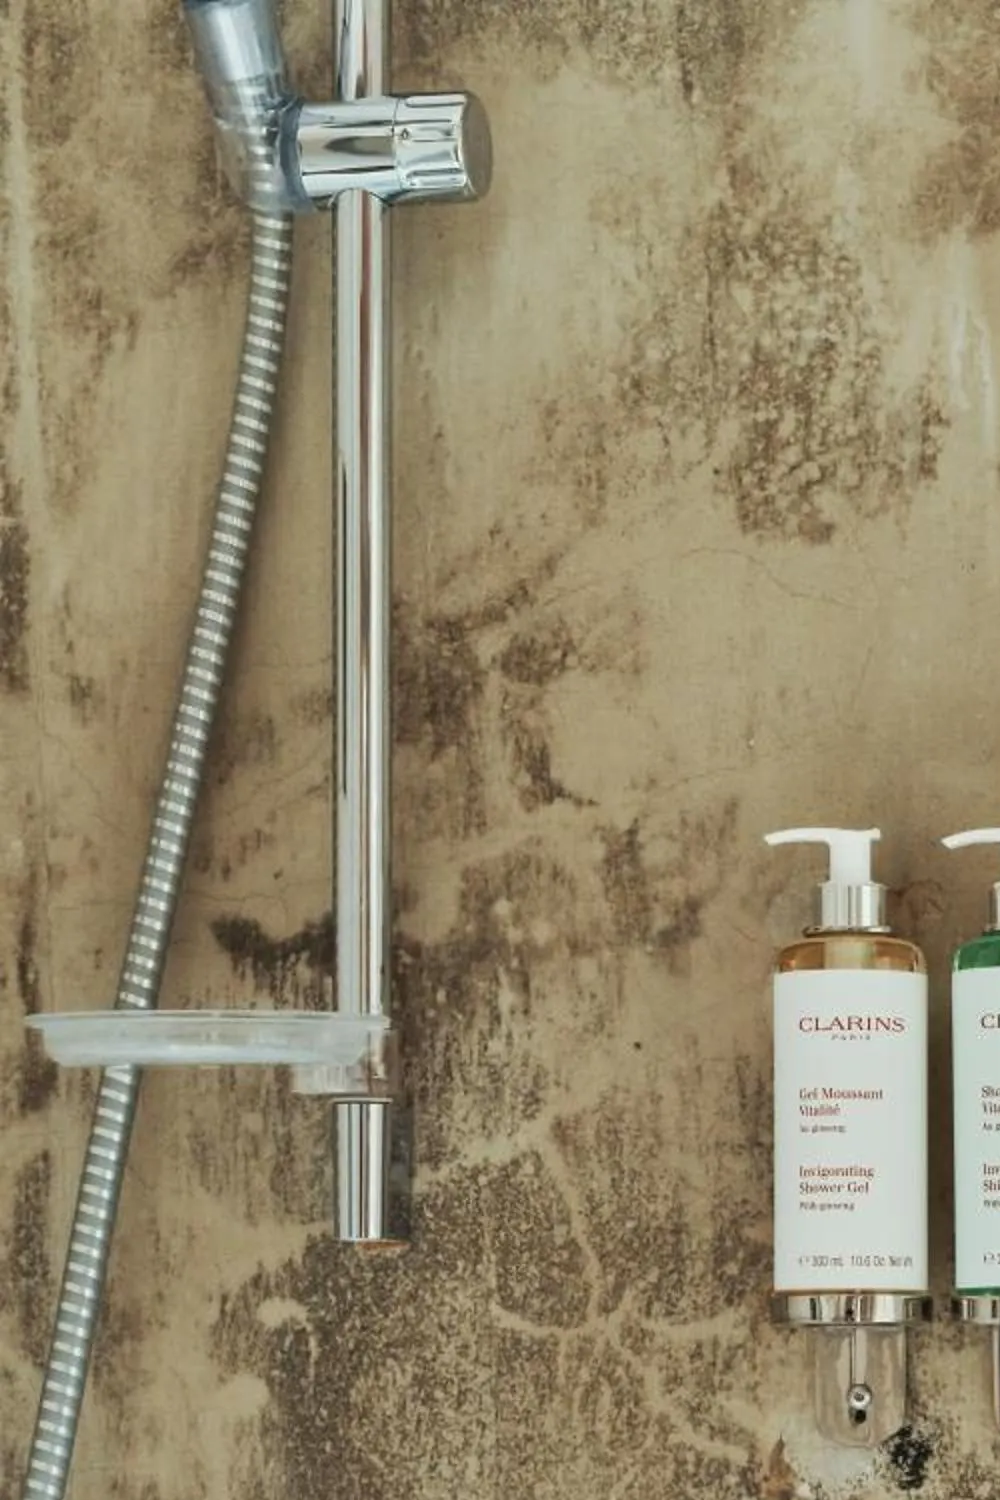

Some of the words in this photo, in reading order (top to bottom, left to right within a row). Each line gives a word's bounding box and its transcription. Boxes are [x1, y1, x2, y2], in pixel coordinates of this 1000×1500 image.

[799, 1015, 906, 1032] CLARINS
[821, 1087, 884, 1100] Moussant
[799, 1165, 875, 1180] Invigorating
[799, 1181, 845, 1194] Shower
[847, 1181, 869, 1194] Gel
